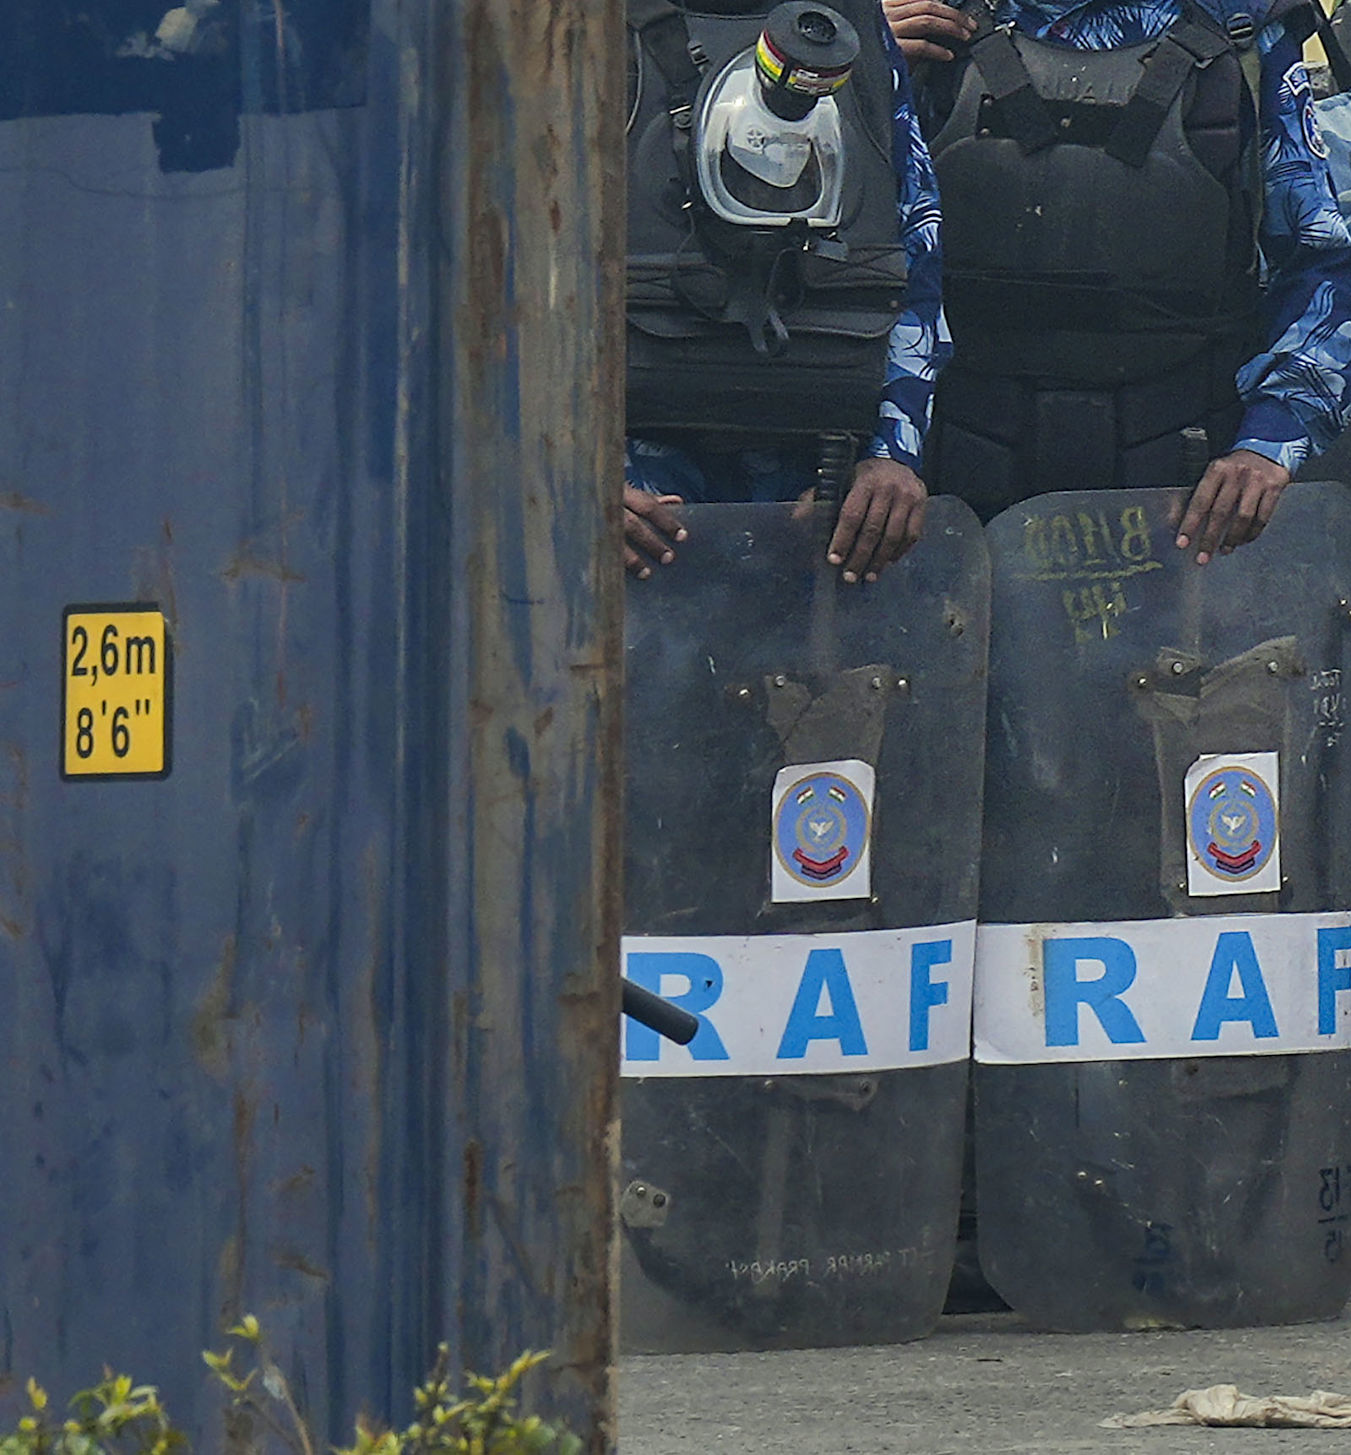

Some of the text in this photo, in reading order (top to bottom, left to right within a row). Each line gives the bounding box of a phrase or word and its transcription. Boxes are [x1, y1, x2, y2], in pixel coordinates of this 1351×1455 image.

[71, 624, 157, 687] 2,6m
[75, 699, 150, 759] 8'6"
[625, 939, 953, 1061] RAF
